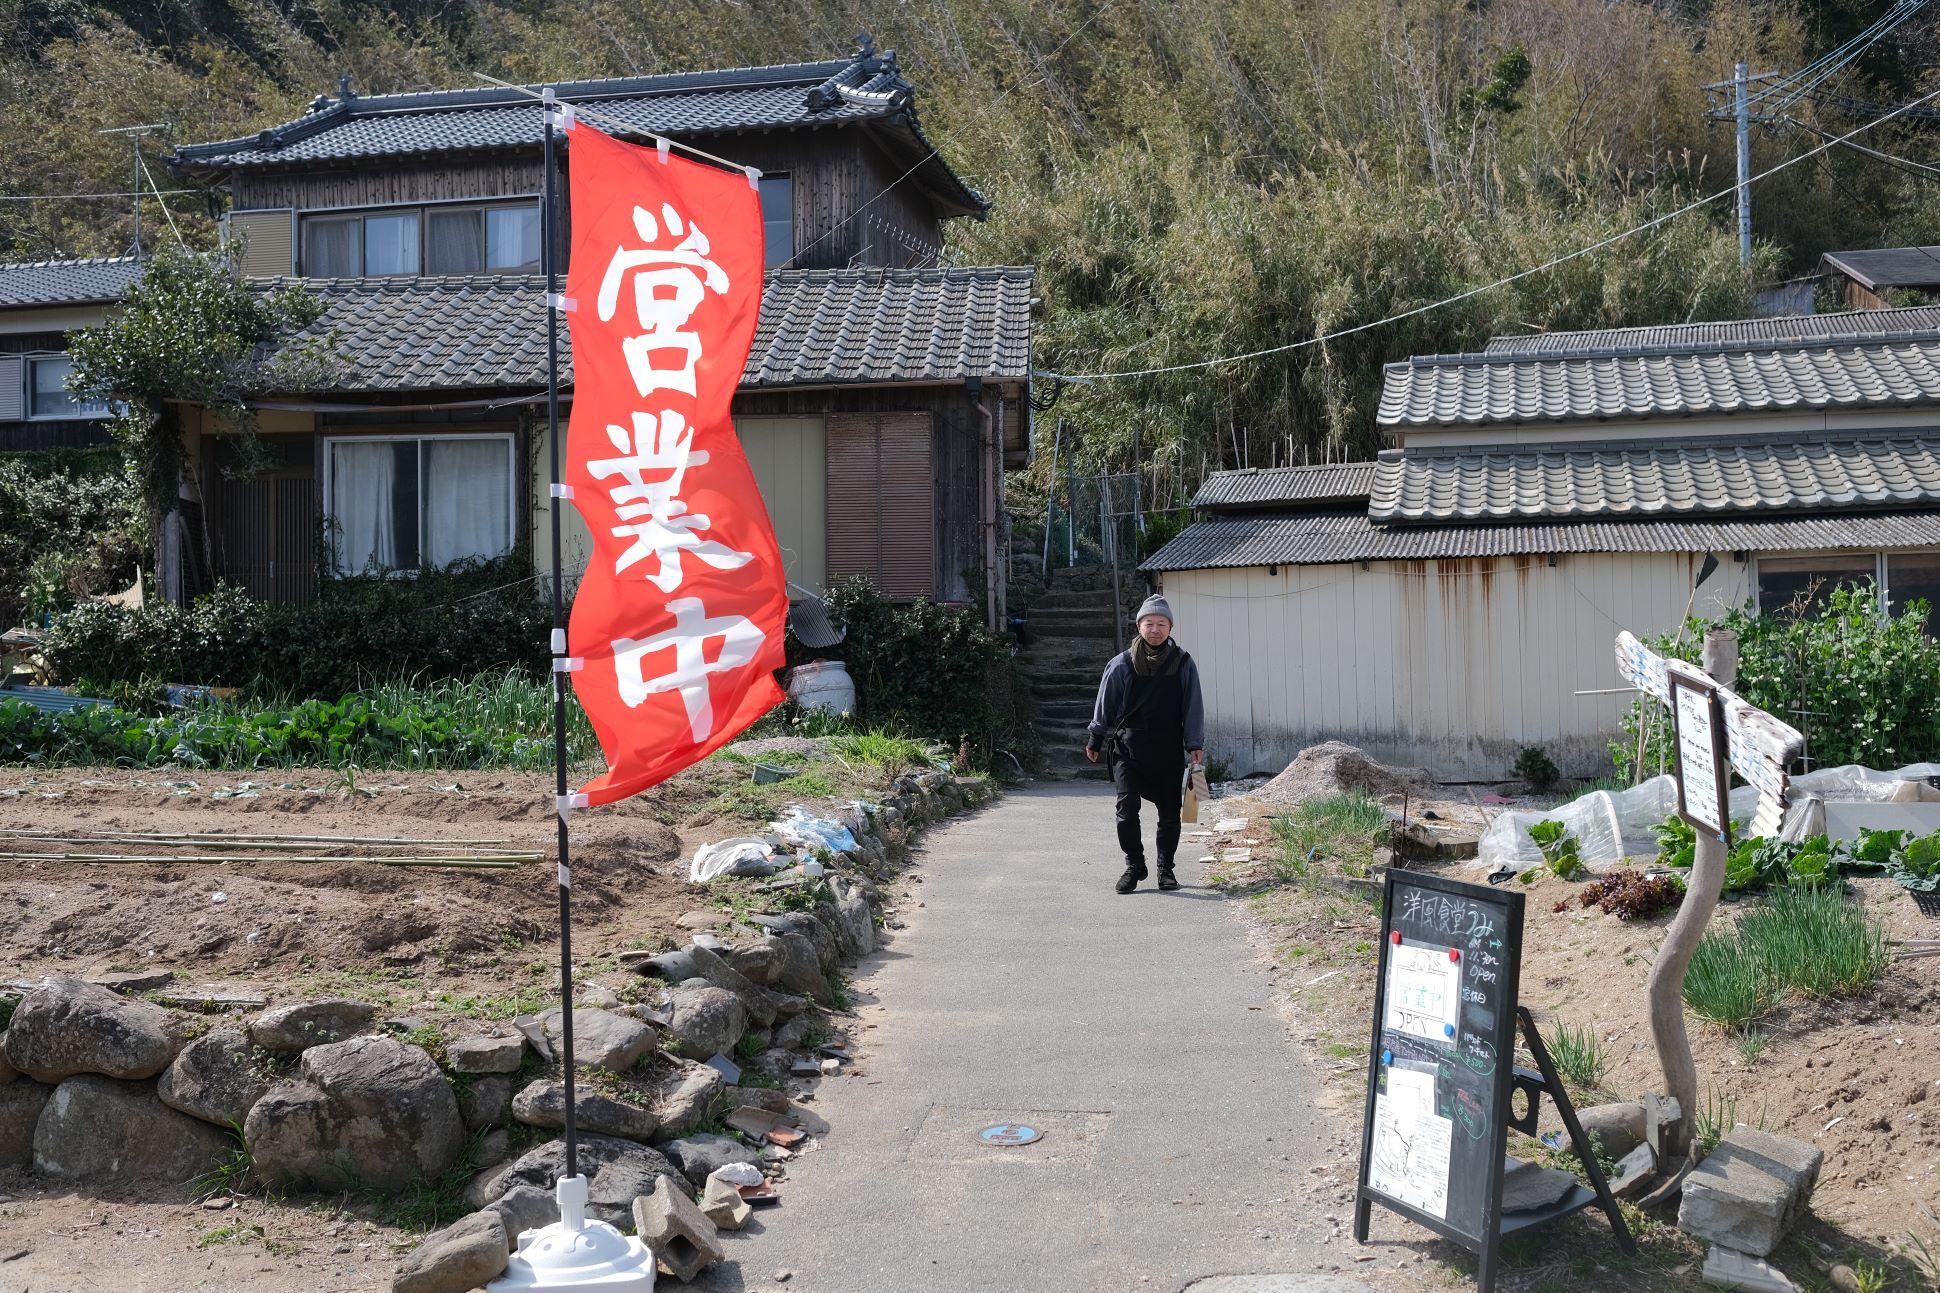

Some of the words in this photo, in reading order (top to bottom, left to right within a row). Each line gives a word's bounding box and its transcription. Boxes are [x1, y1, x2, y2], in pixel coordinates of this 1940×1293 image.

[587, 202, 766, 743] 営業中
[1402, 890, 1494, 937] 洋風食堂うみ
